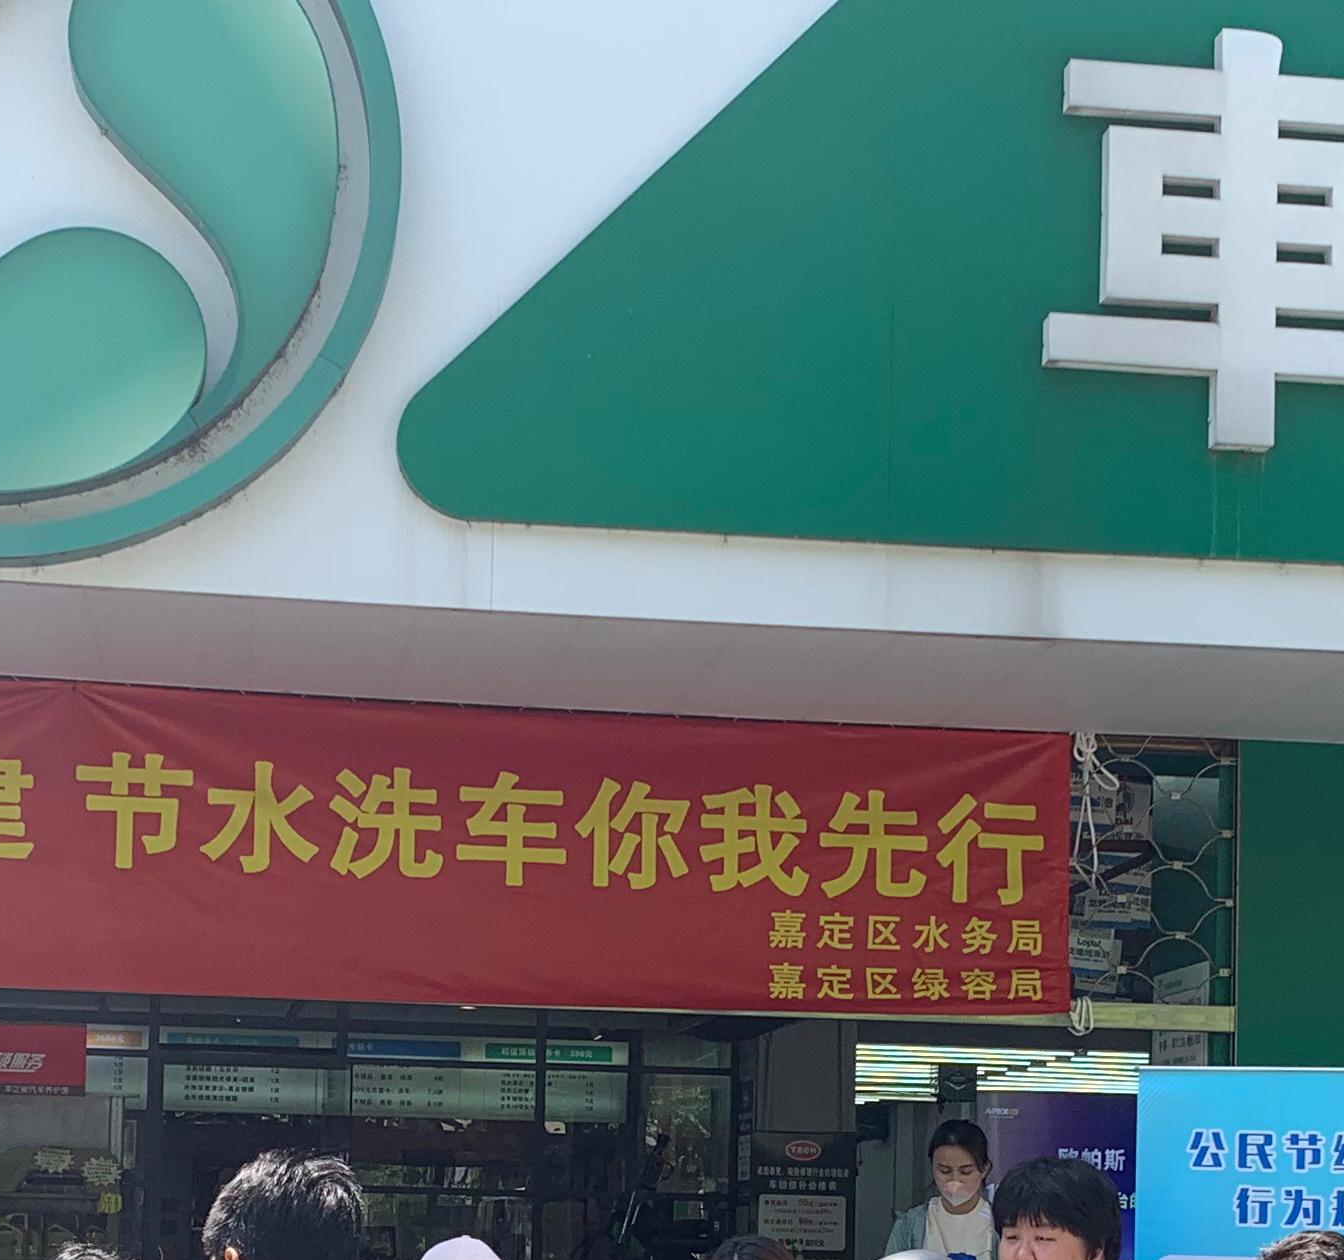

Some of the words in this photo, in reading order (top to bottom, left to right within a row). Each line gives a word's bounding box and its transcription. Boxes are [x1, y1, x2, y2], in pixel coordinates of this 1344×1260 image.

[76, 751, 1046, 906] 节水洗车你我先行
[768, 909, 1044, 958] 嘉定区水务局
[768, 962, 1044, 1003] 嘉定区绿容局
